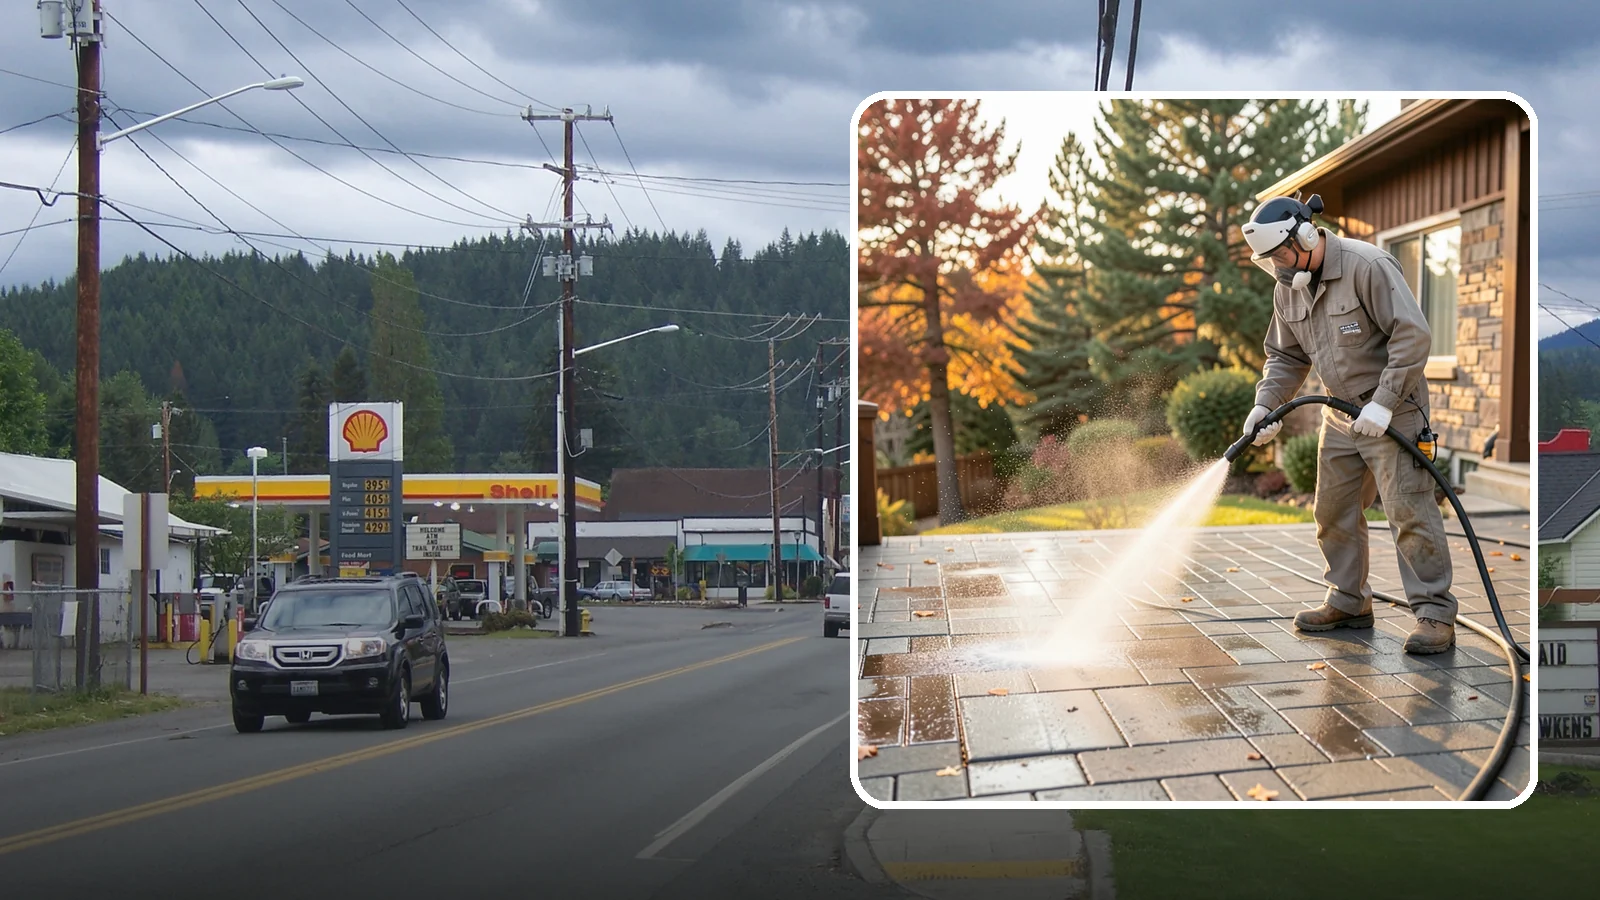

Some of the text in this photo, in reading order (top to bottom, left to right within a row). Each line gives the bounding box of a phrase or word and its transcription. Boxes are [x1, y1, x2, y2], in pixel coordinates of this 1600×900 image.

[365, 480, 384, 490] 395
[490, 484, 547, 499] Shell
[365, 494, 384, 504] 405
[365, 508, 384, 518] 415
[365, 522, 384, 532] 429
[1538, 643, 1567, 665] AID
